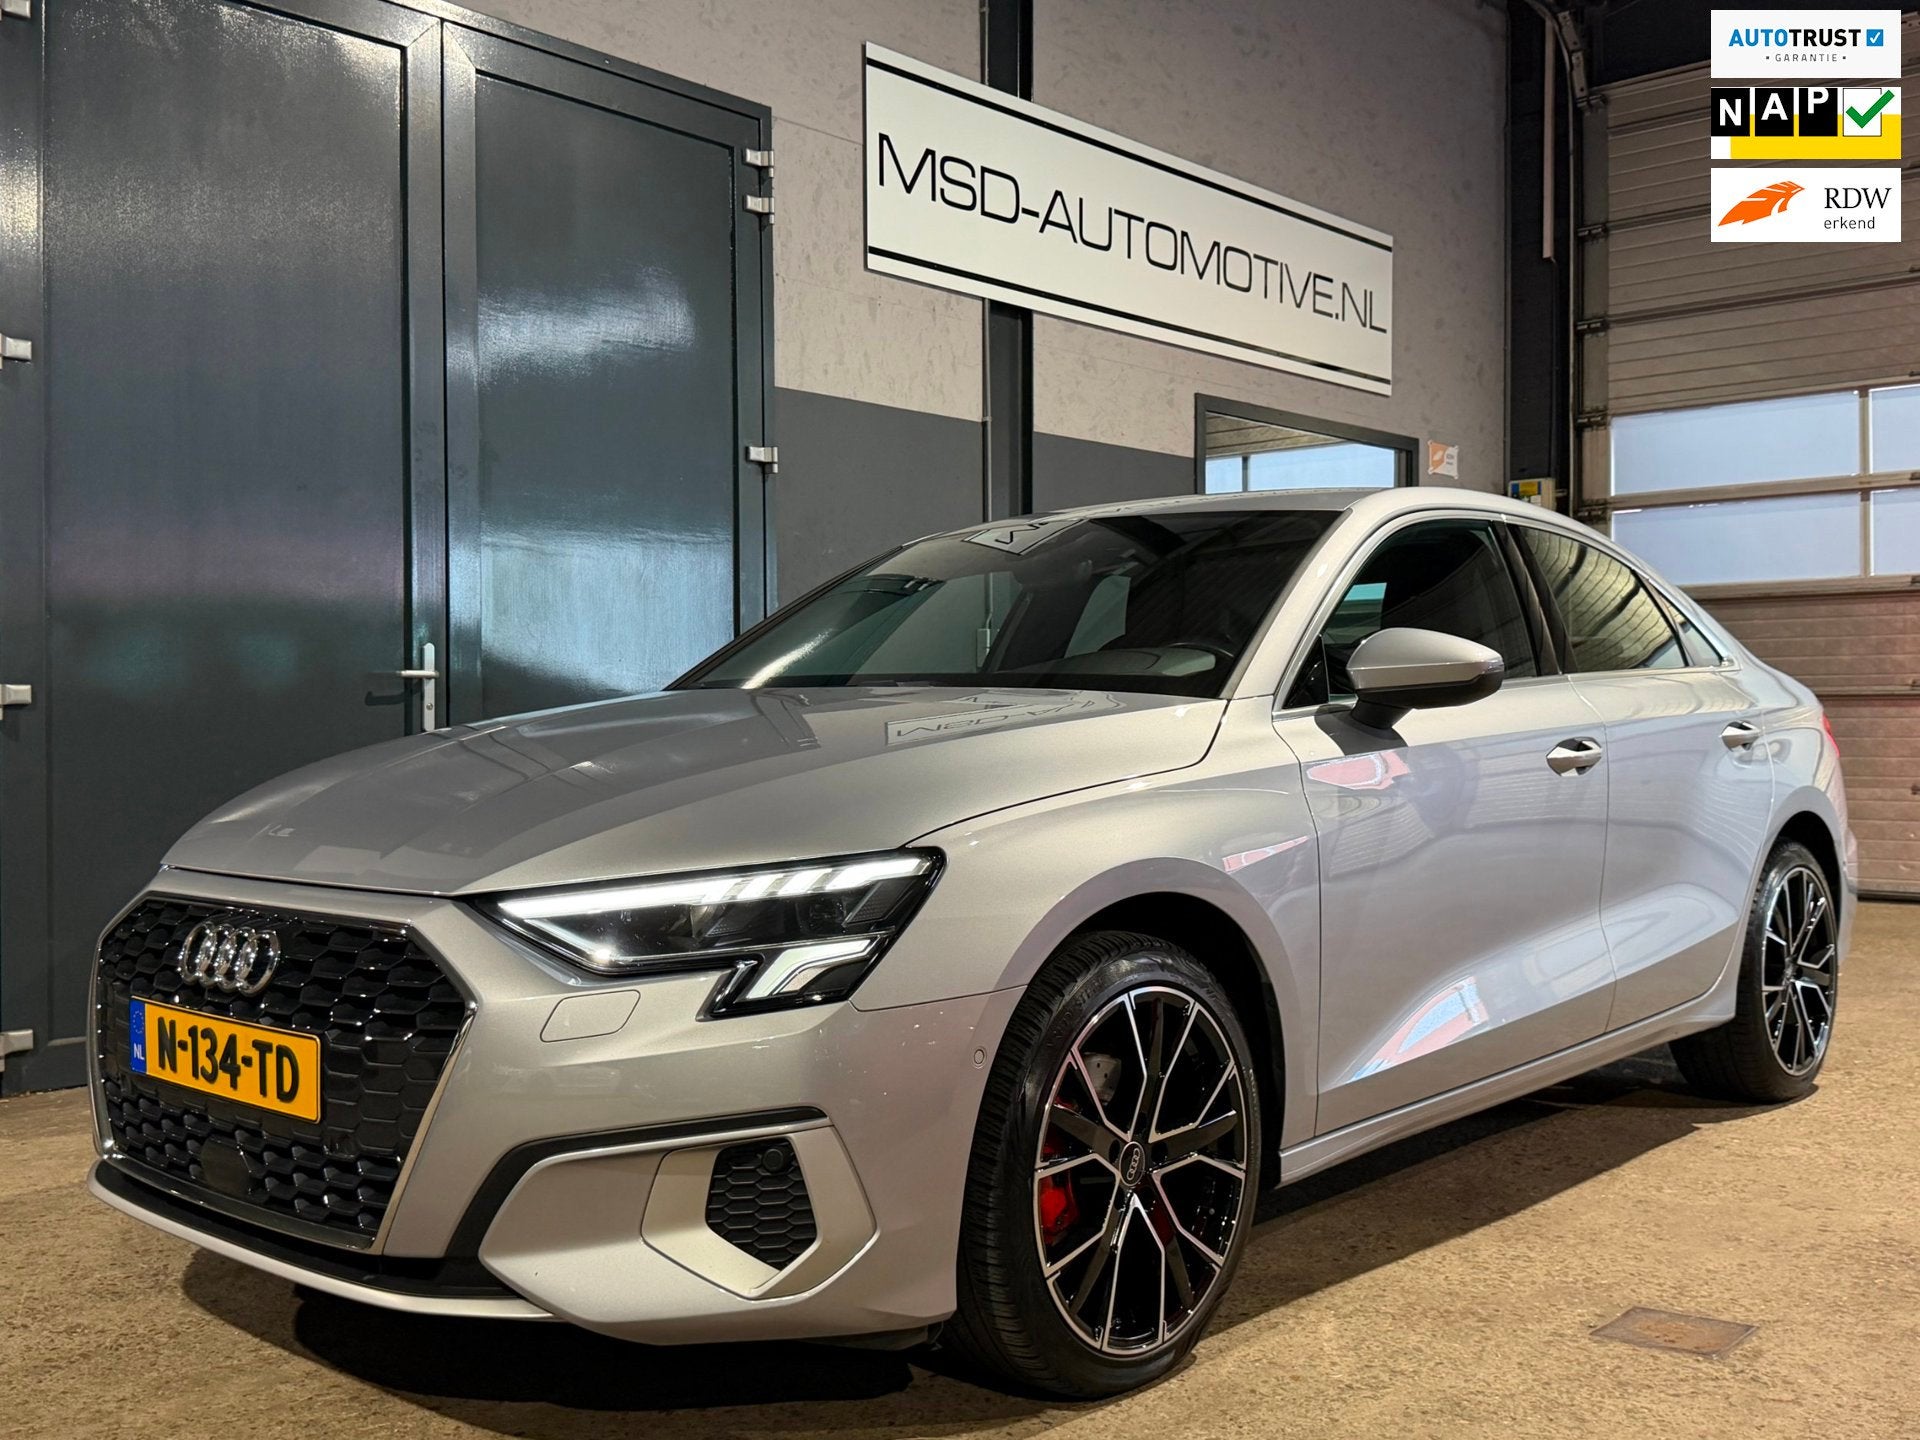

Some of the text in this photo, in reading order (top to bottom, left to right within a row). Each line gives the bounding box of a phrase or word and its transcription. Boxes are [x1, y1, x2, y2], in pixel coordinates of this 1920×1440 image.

[878, 132, 1387, 334] MSD-AUTOMOTIVE.NL
[133, 1043, 145, 1061] NL
[157, 1016, 300, 1102] N-134-TD
